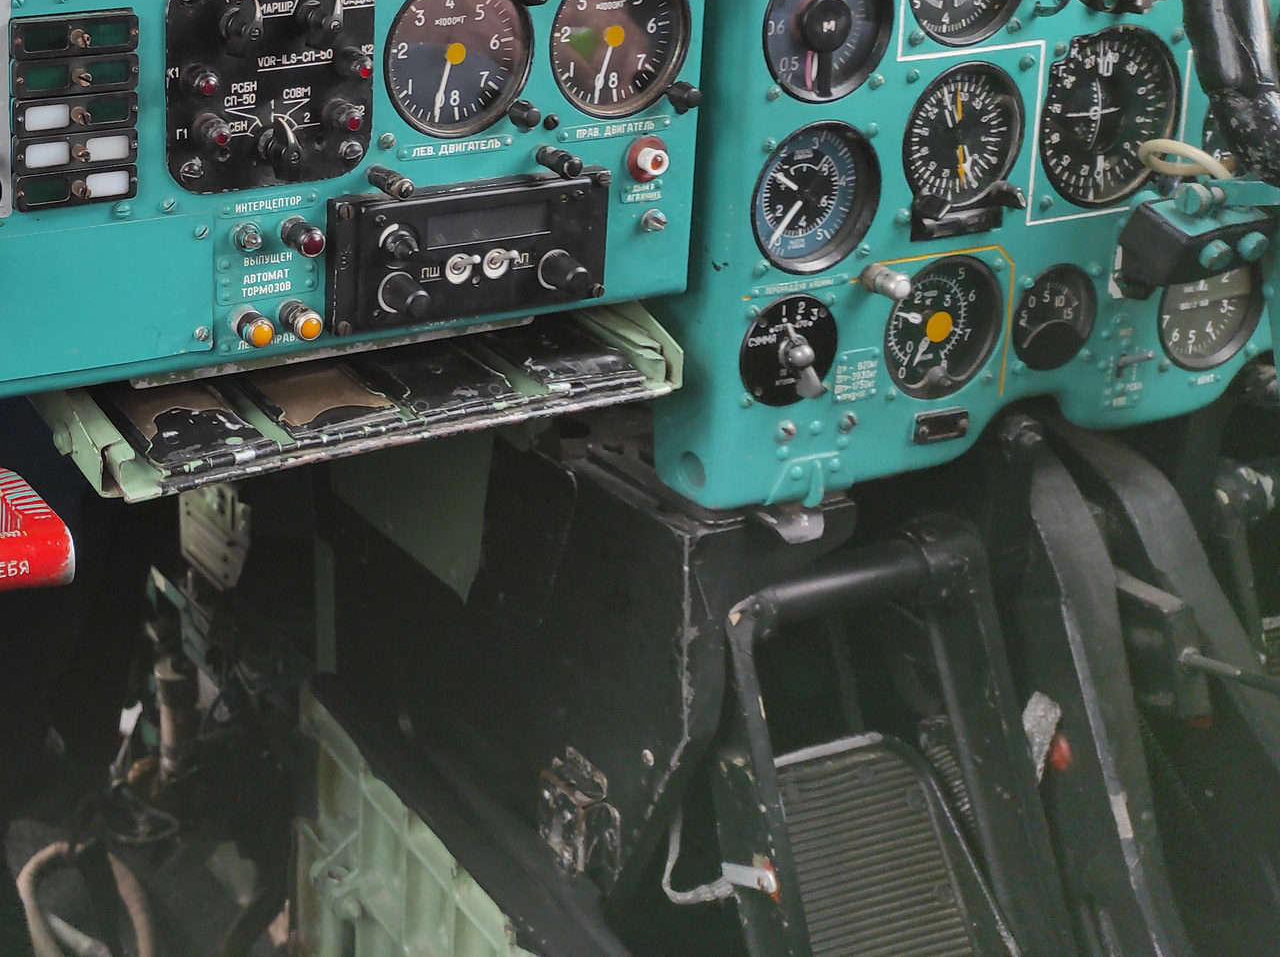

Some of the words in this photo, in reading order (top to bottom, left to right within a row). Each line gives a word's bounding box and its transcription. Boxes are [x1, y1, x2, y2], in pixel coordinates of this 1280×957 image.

[231, 80, 257, 93] РСБН
[283, 85, 311, 100] СОВМ
[224, 93, 256, 107] СП-50
[576, 125, 602, 139] ПРАВ.
[604, 119, 655, 137] ДВИГАТЕЛЬ
[412, 144, 436, 158] ЛЕВ.
[438, 138, 501, 156] ДВИГАТЕЛЬ
[235, 195, 302, 214] ИНТЕРЦЕПТОР
[243, 251, 293, 268] ВЫПУЩЕН
[243, 268, 290, 285] АВТОМАТ
[241, 280, 292, 298] ТОРМОЗОВ
